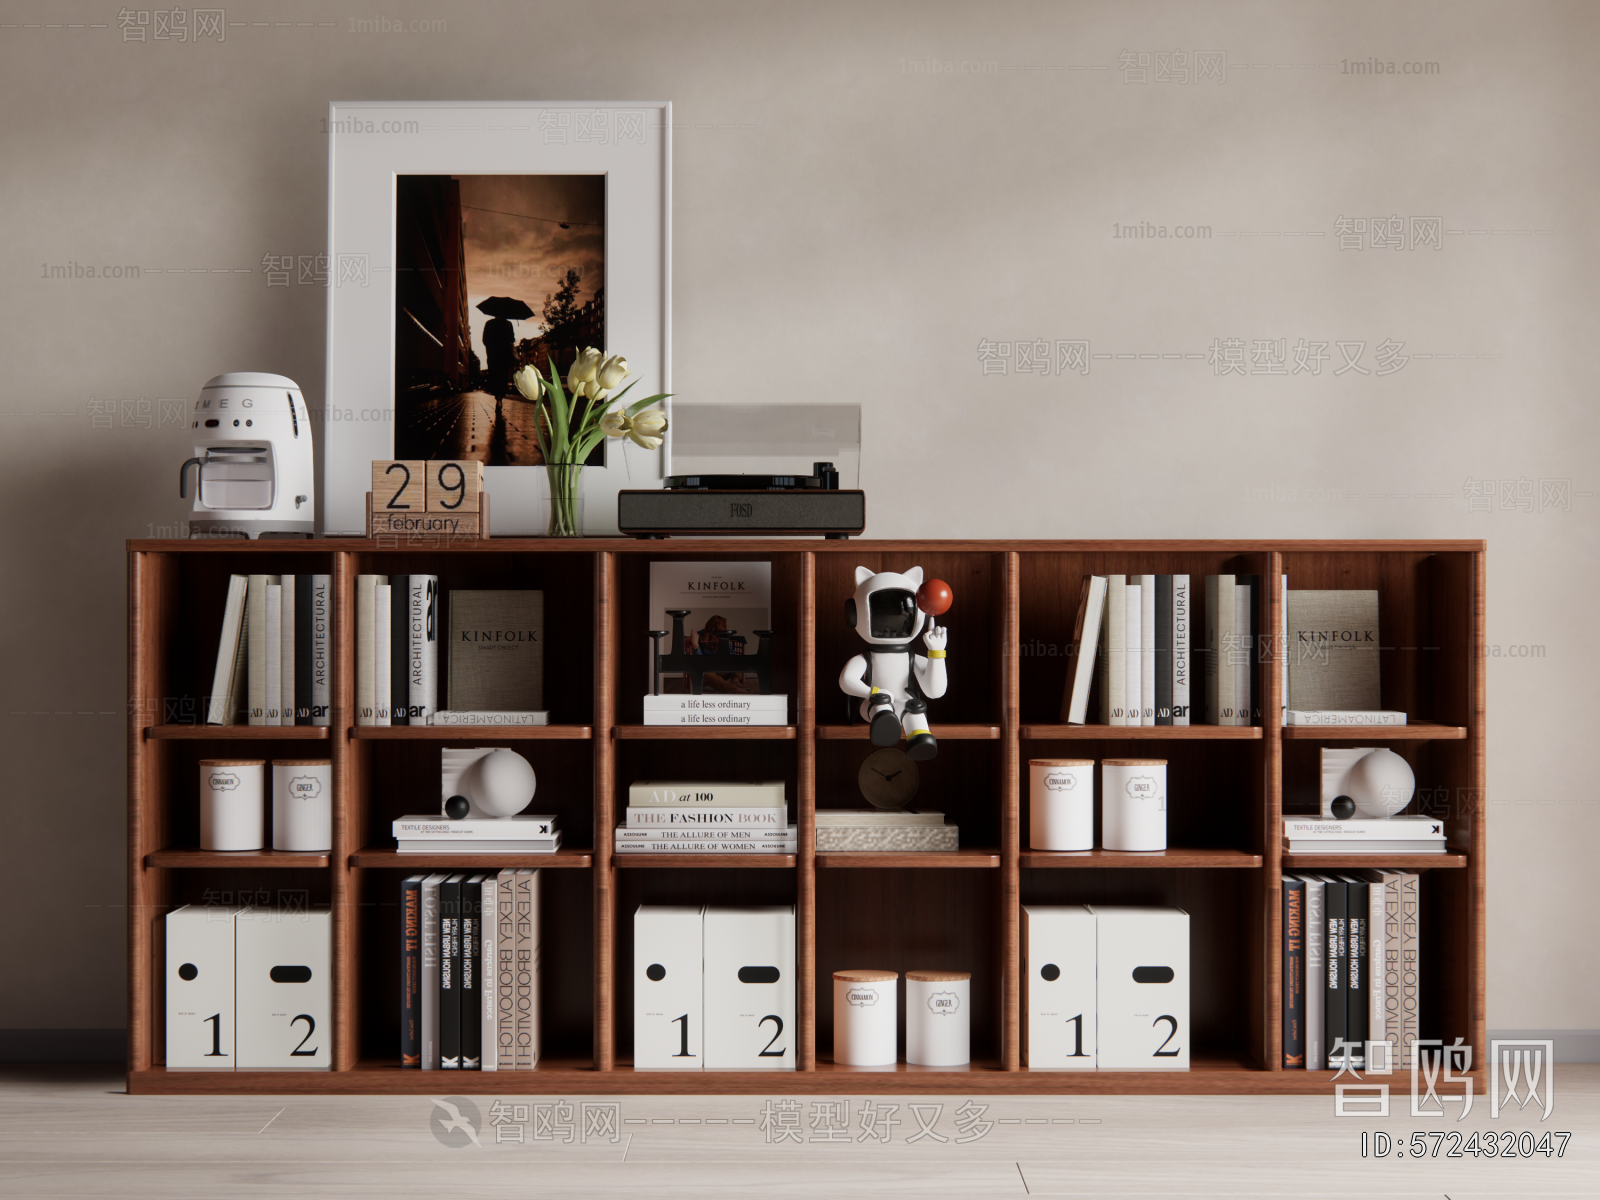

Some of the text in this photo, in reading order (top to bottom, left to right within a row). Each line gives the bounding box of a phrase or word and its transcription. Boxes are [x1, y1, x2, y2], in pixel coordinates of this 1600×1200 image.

[385, 463, 466, 509] 2 9
[387, 514, 460, 532] february
[687, 581, 746, 591] KINFOLK
[316, 584, 326, 685] ARCHITECTURAL
[412, 584, 422, 685] ARCHITECTURAL
[461, 631, 538, 642] KINFOLK
[1176, 584, 1186, 685] ARCHITECTURAL
[1297, 631, 1375, 642] KINFOLK
[312, 705, 329, 718] ar
[409, 705, 426, 718] ar
[688, 700, 700, 708] life
[702, 700, 715, 708] less
[717, 700, 751, 710] ordinary
[1172, 705, 1190, 718] ar
[688, 714, 700, 722] life
[702, 714, 715, 722] less
[717, 714, 751, 724] ordinary
[296, 783, 314, 792] GINGER
[1133, 783, 1151, 792] GINGER
[648, 790, 714, 803] AD at 100
[634, 813, 777, 824] THE FASHION BOOK
[936, 999, 952, 1008] GINGER
[203, 1012, 229, 1056] 1
[290, 1014, 318, 1056] 2
[671, 1014, 696, 1057] 1
[758, 1014, 786, 1057] 2
[1066, 1014, 1091, 1057] 1
[1152, 1014, 1181, 1057] 2
